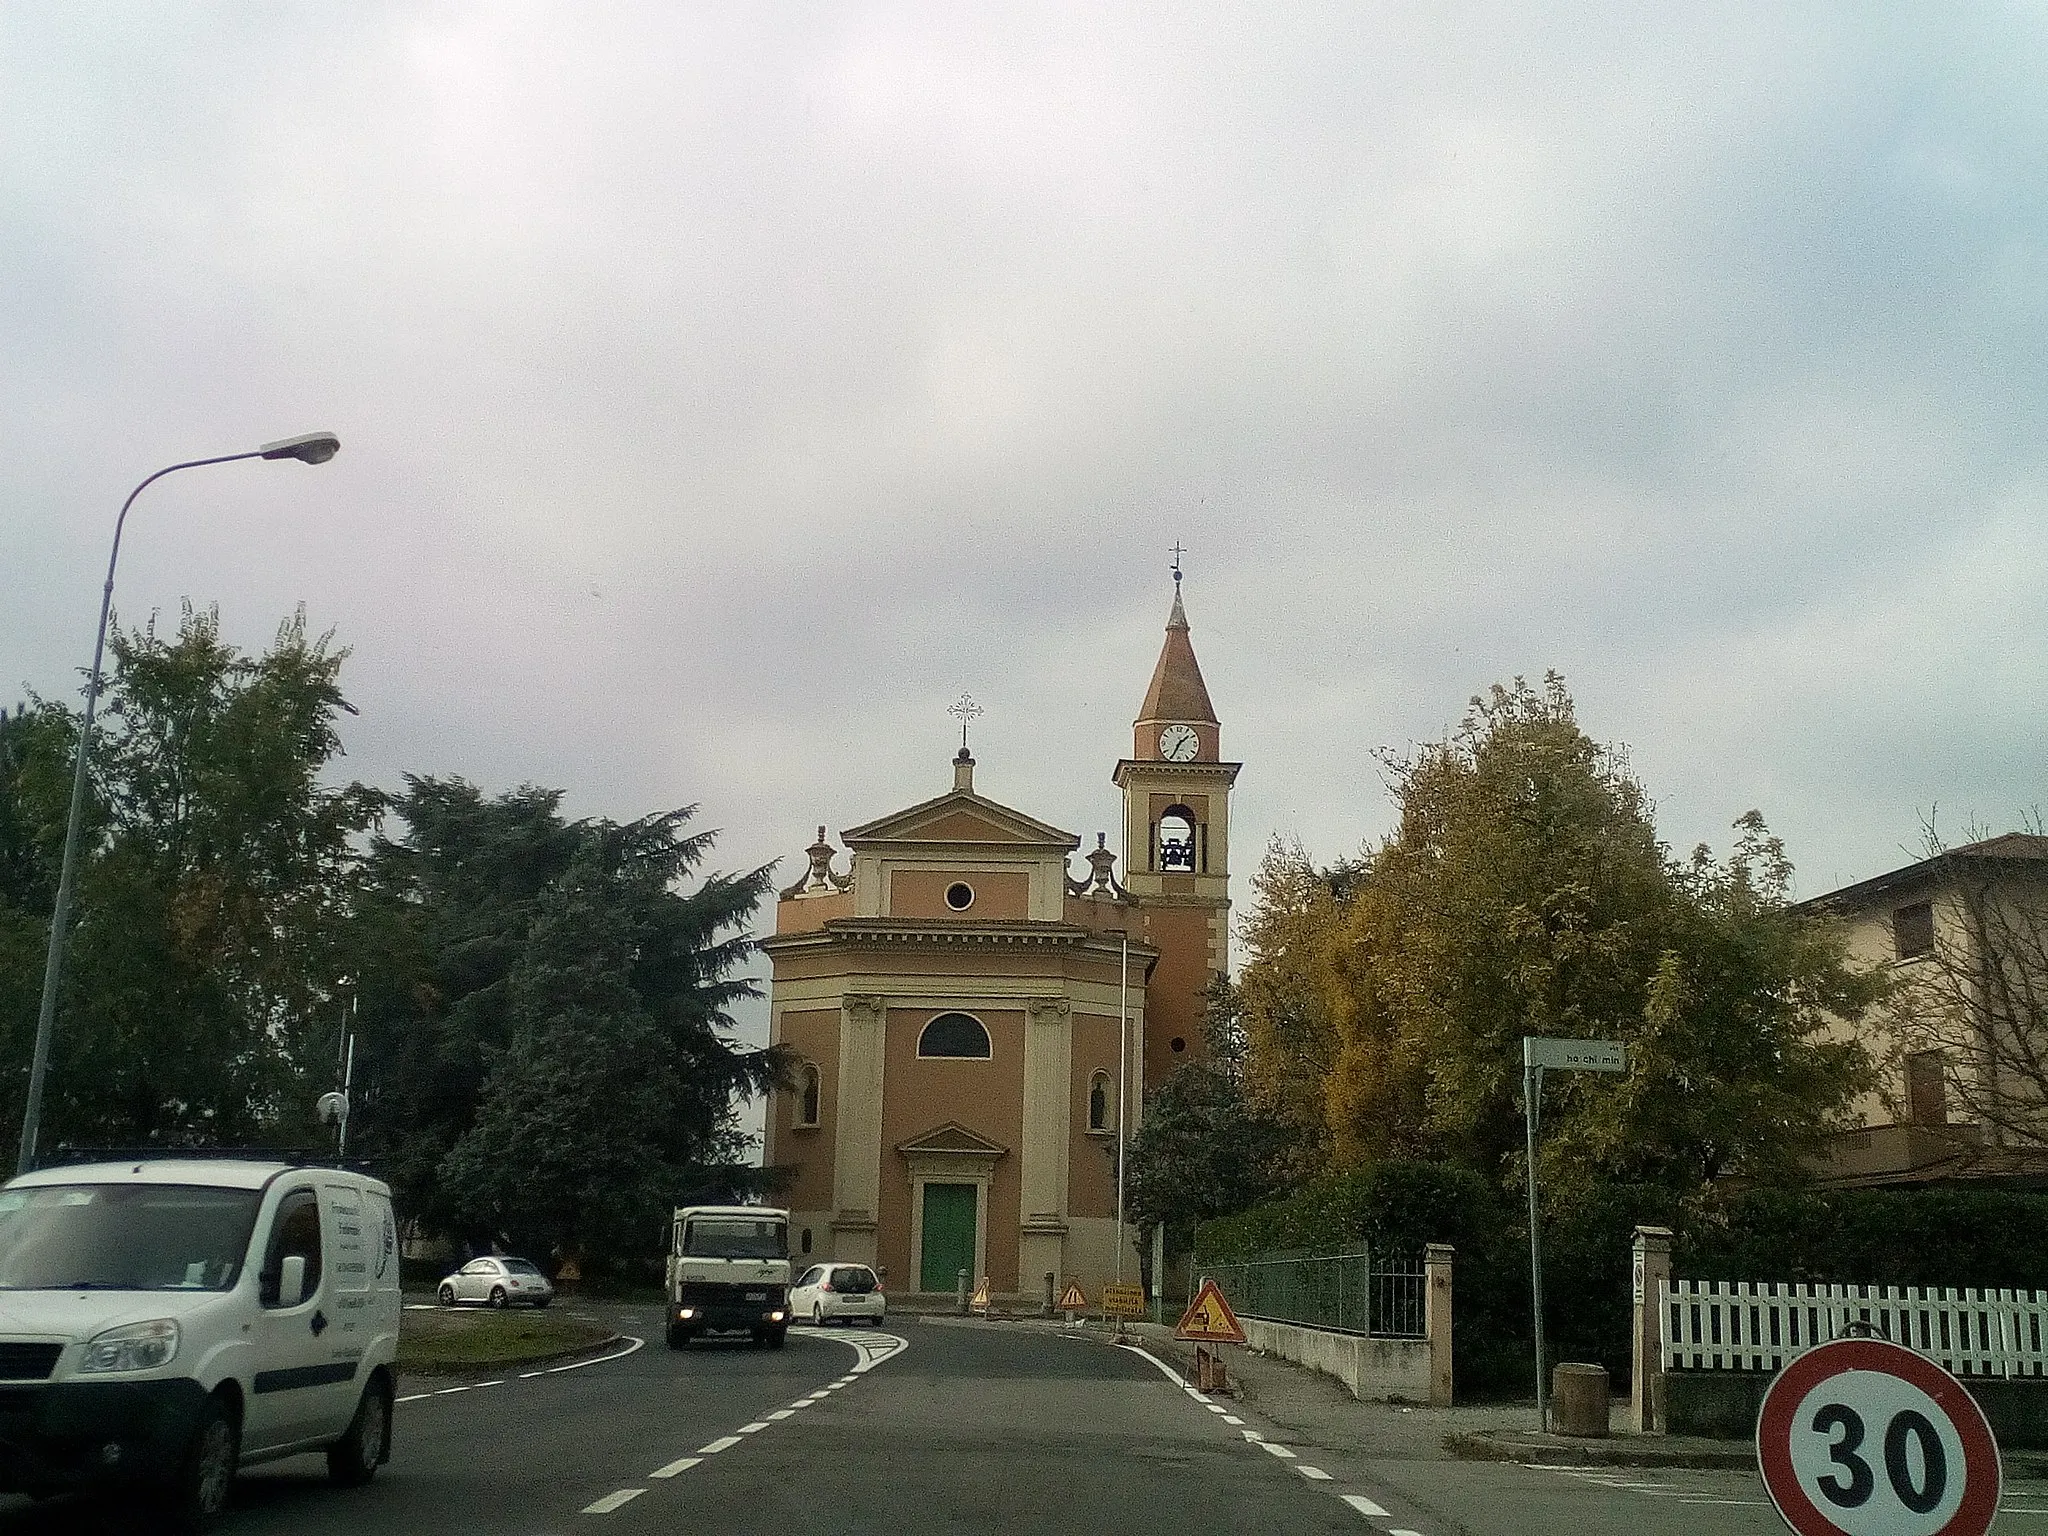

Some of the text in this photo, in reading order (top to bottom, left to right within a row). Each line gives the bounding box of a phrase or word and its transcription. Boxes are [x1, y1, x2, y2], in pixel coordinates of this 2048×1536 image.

[1567, 1055, 1579, 1063] ho
[1583, 1056, 1597, 1064] chi
[1812, 1403, 1947, 1515] 30
